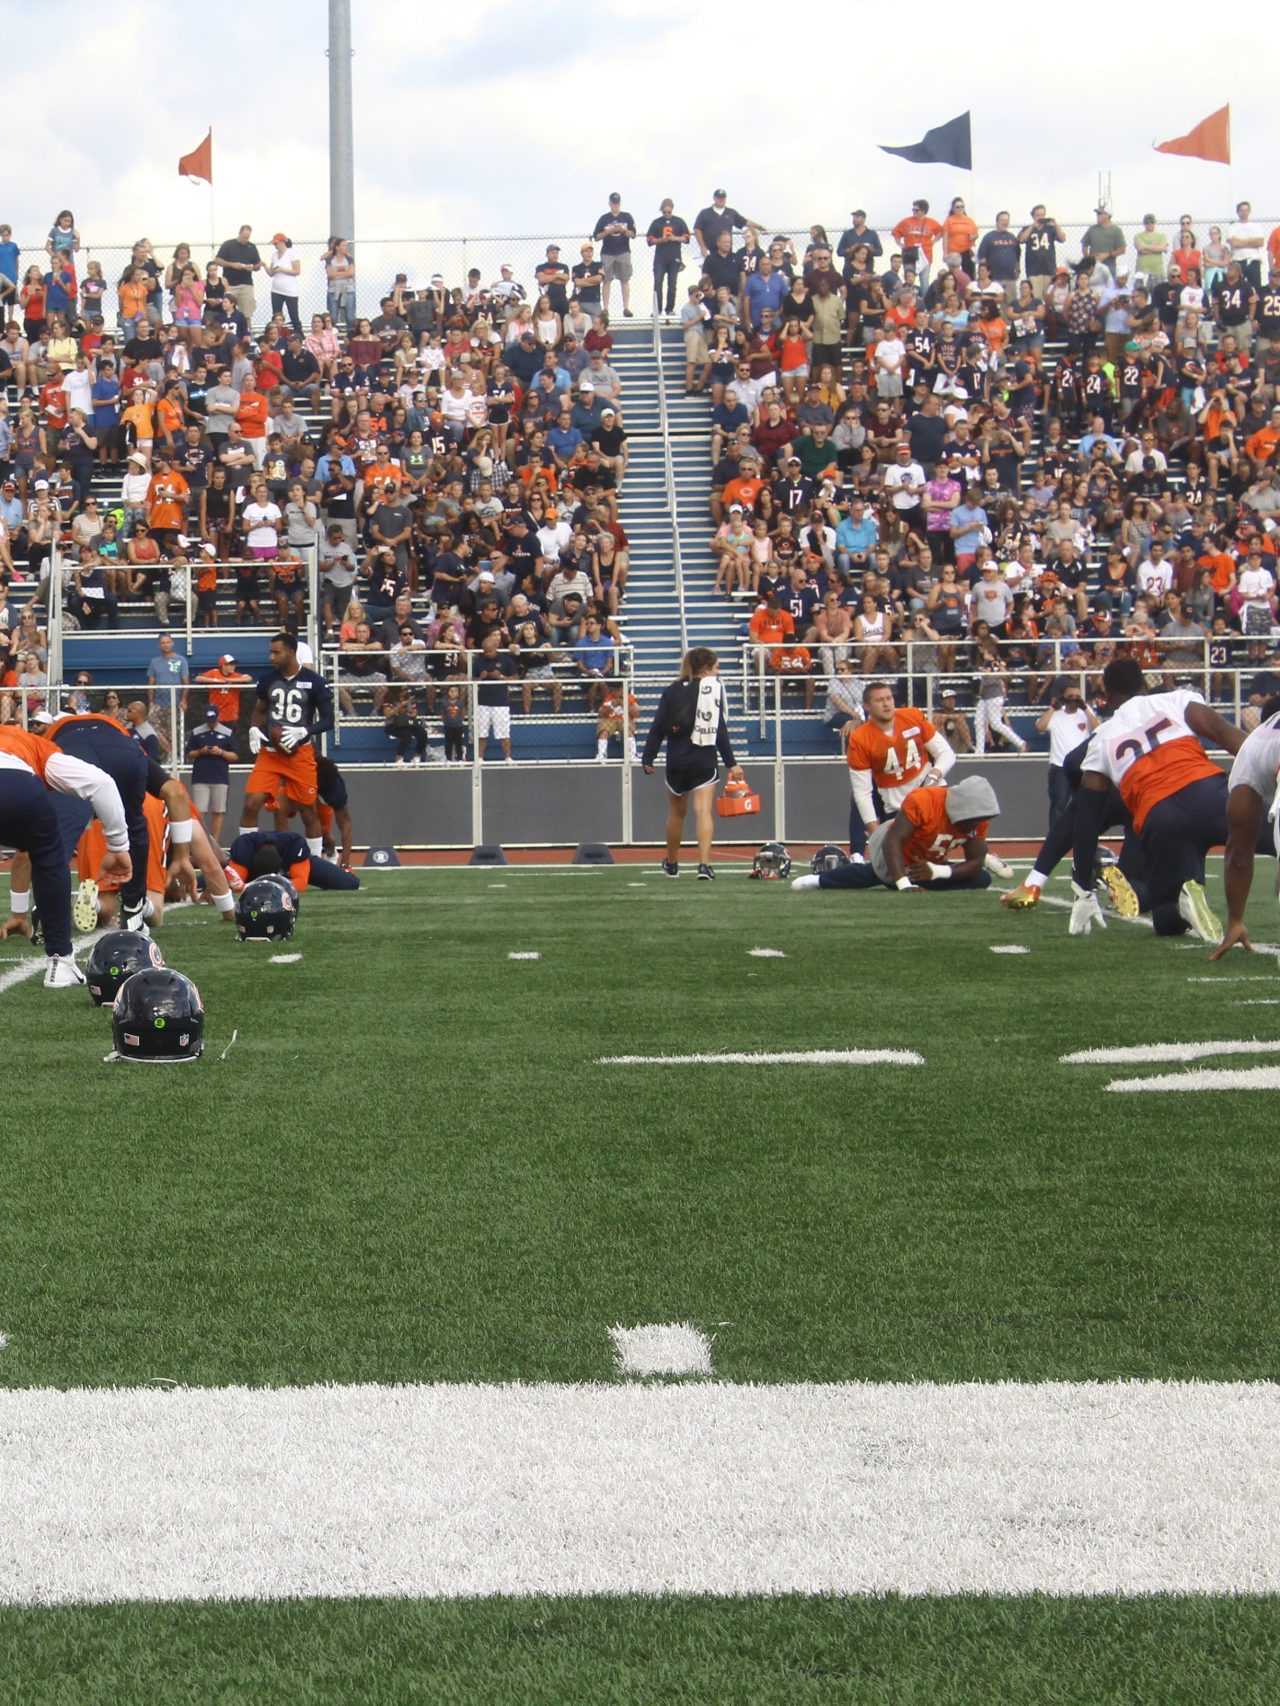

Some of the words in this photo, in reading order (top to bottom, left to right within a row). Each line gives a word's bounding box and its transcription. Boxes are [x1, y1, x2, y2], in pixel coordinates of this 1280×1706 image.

[1030, 232, 1050, 251] 34
[742, 254, 757, 273] 34
[1221, 289, 1241, 310] 34
[914, 336, 930, 353] 54
[1086, 376, 1102, 394] 24
[1123, 367, 1139, 386] 22
[431, 436, 447, 455] 15
[789, 489, 803, 509] 17
[789, 599, 803, 618] 51
[780, 656, 804, 669] 54
[1210, 647, 1227, 664] 23
[271, 688, 303, 723] 36
[882, 738, 922, 781] 44
[744, 798, 752, 811] G
